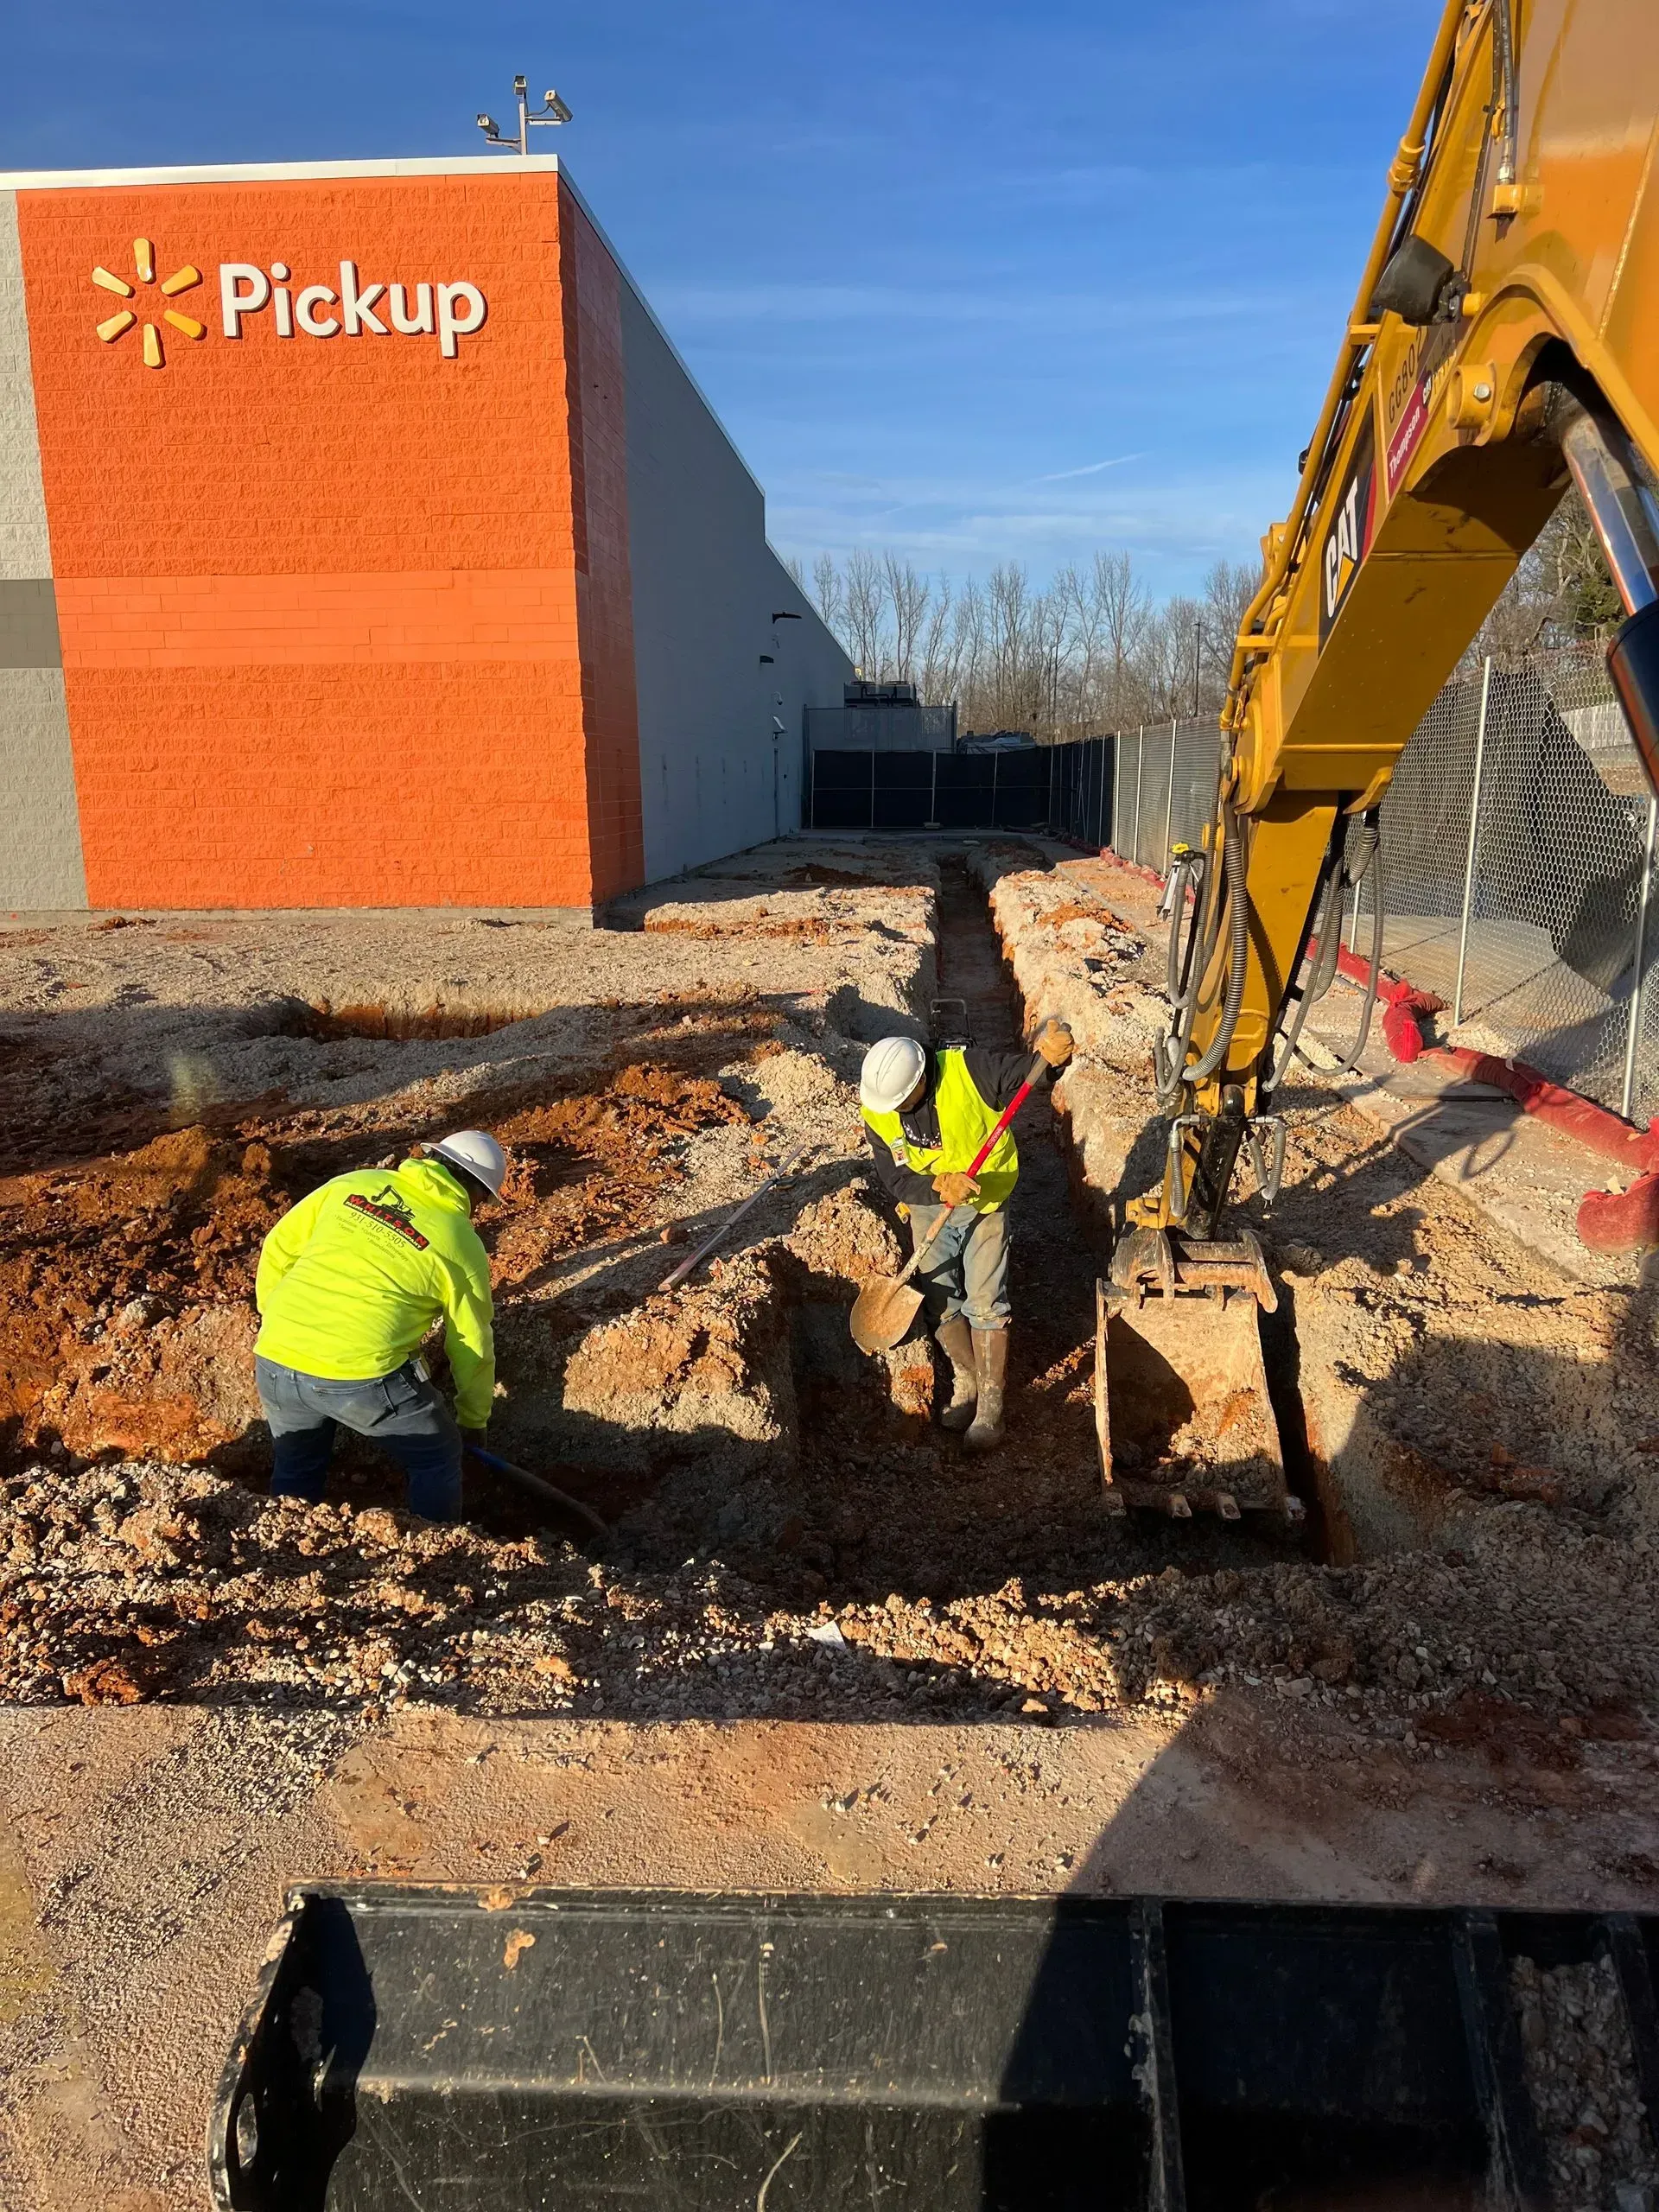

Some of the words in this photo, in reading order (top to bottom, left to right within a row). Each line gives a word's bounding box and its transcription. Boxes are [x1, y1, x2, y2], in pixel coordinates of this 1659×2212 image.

[219, 260, 487, 358] Pickup
[1389, 326, 1428, 423] GG802
[1389, 405, 1421, 478] Thompson
[1325, 476, 1358, 618] CAT
[348, 1211, 407, 1248] 931-510-5505
[350, 1195, 428, 1247] WHITSON
[363, 1209, 397, 1230] EXCAVATION
[395, 1226, 422, 1249] COMPANY
